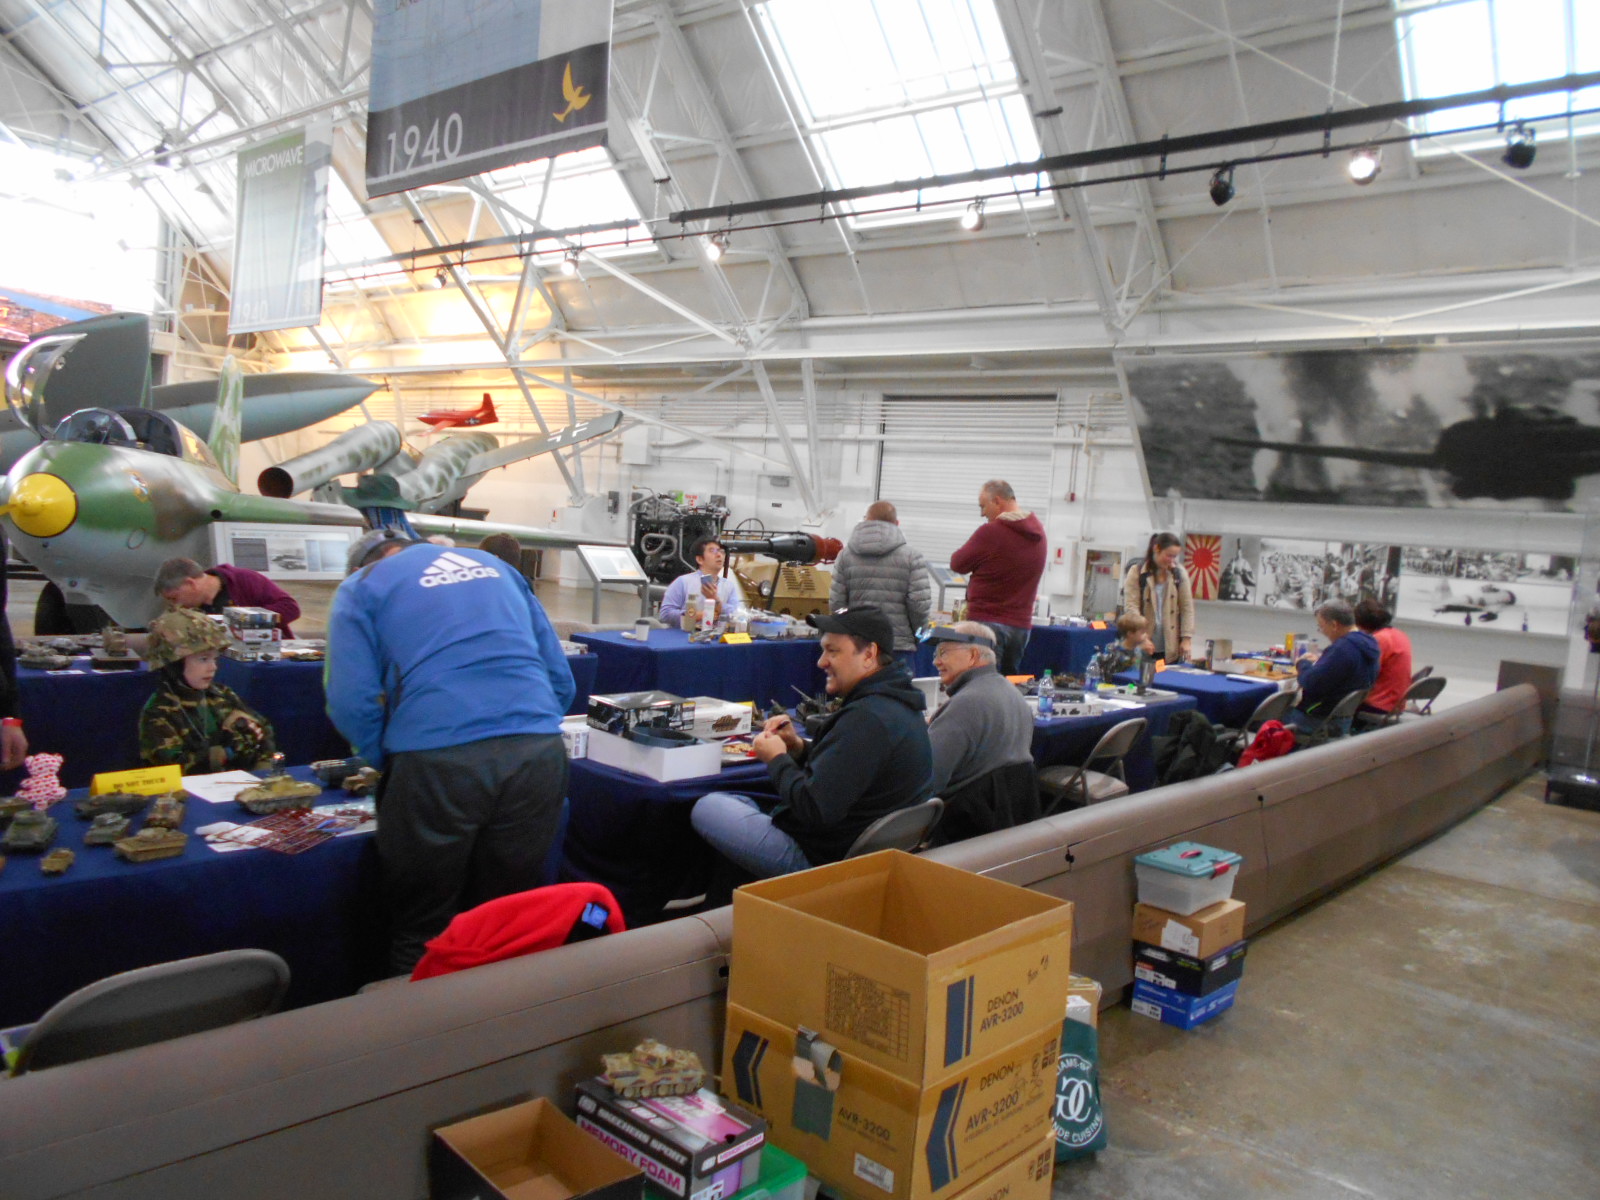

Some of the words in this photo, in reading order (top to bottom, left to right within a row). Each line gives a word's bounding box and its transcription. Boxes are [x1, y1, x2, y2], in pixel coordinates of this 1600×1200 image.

[387, 113, 463, 176] 1940
[244, 145, 304, 178] MICROWAVE
[419, 567, 500, 587] adidas
[980, 1002, 1024, 1032] AVR-3200
[987, 988, 1019, 1013] DENON
[980, 1062, 1015, 1091] DENON
[838, 1107, 891, 1141] AVR-3200
[965, 1090, 1019, 1133] AVR-3200
[579, 1119, 637, 1164] MEMORY
[639, 1156, 681, 1192] FOAM
